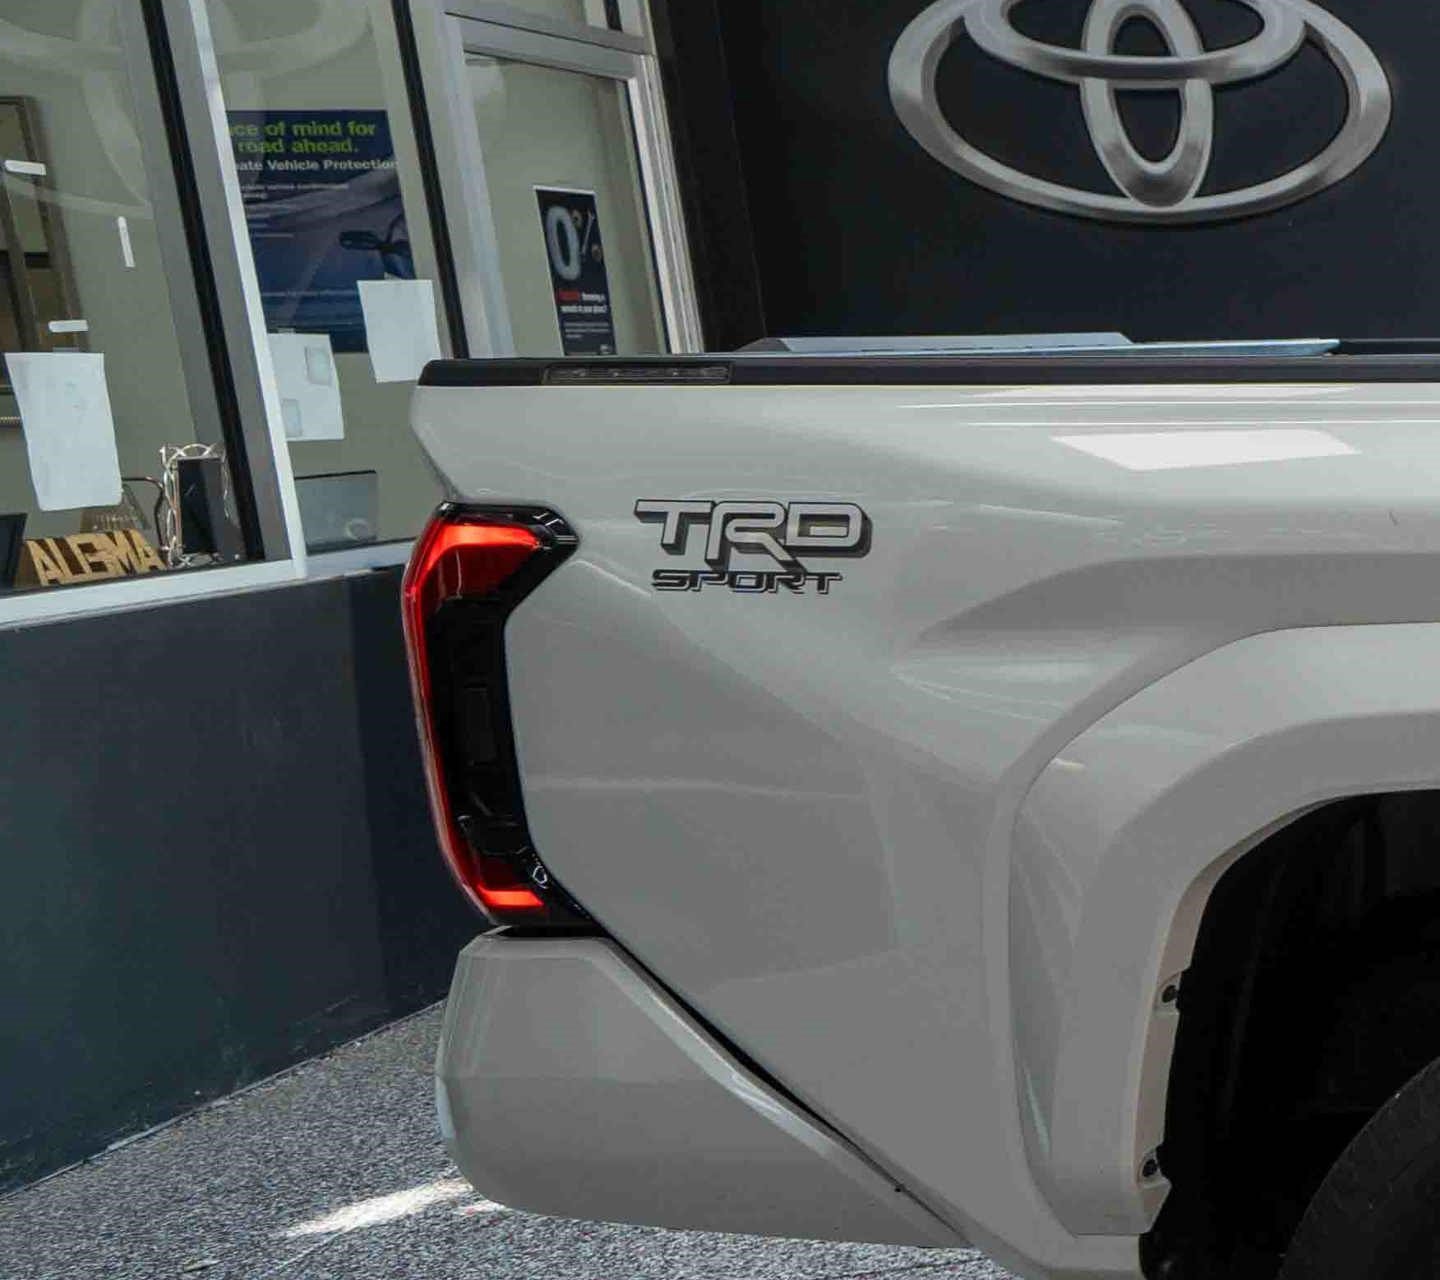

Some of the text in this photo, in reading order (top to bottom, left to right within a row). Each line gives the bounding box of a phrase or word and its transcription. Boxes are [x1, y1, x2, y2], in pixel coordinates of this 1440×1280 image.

[263, 121, 285, 137] of
[292, 121, 342, 137] mind
[347, 121, 376, 137] for
[238, 139, 360, 154] road ahead.
[266, 159, 320, 172] Vehicle
[633, 499, 872, 572] TRD
[651, 569, 844, 595] SPORT
